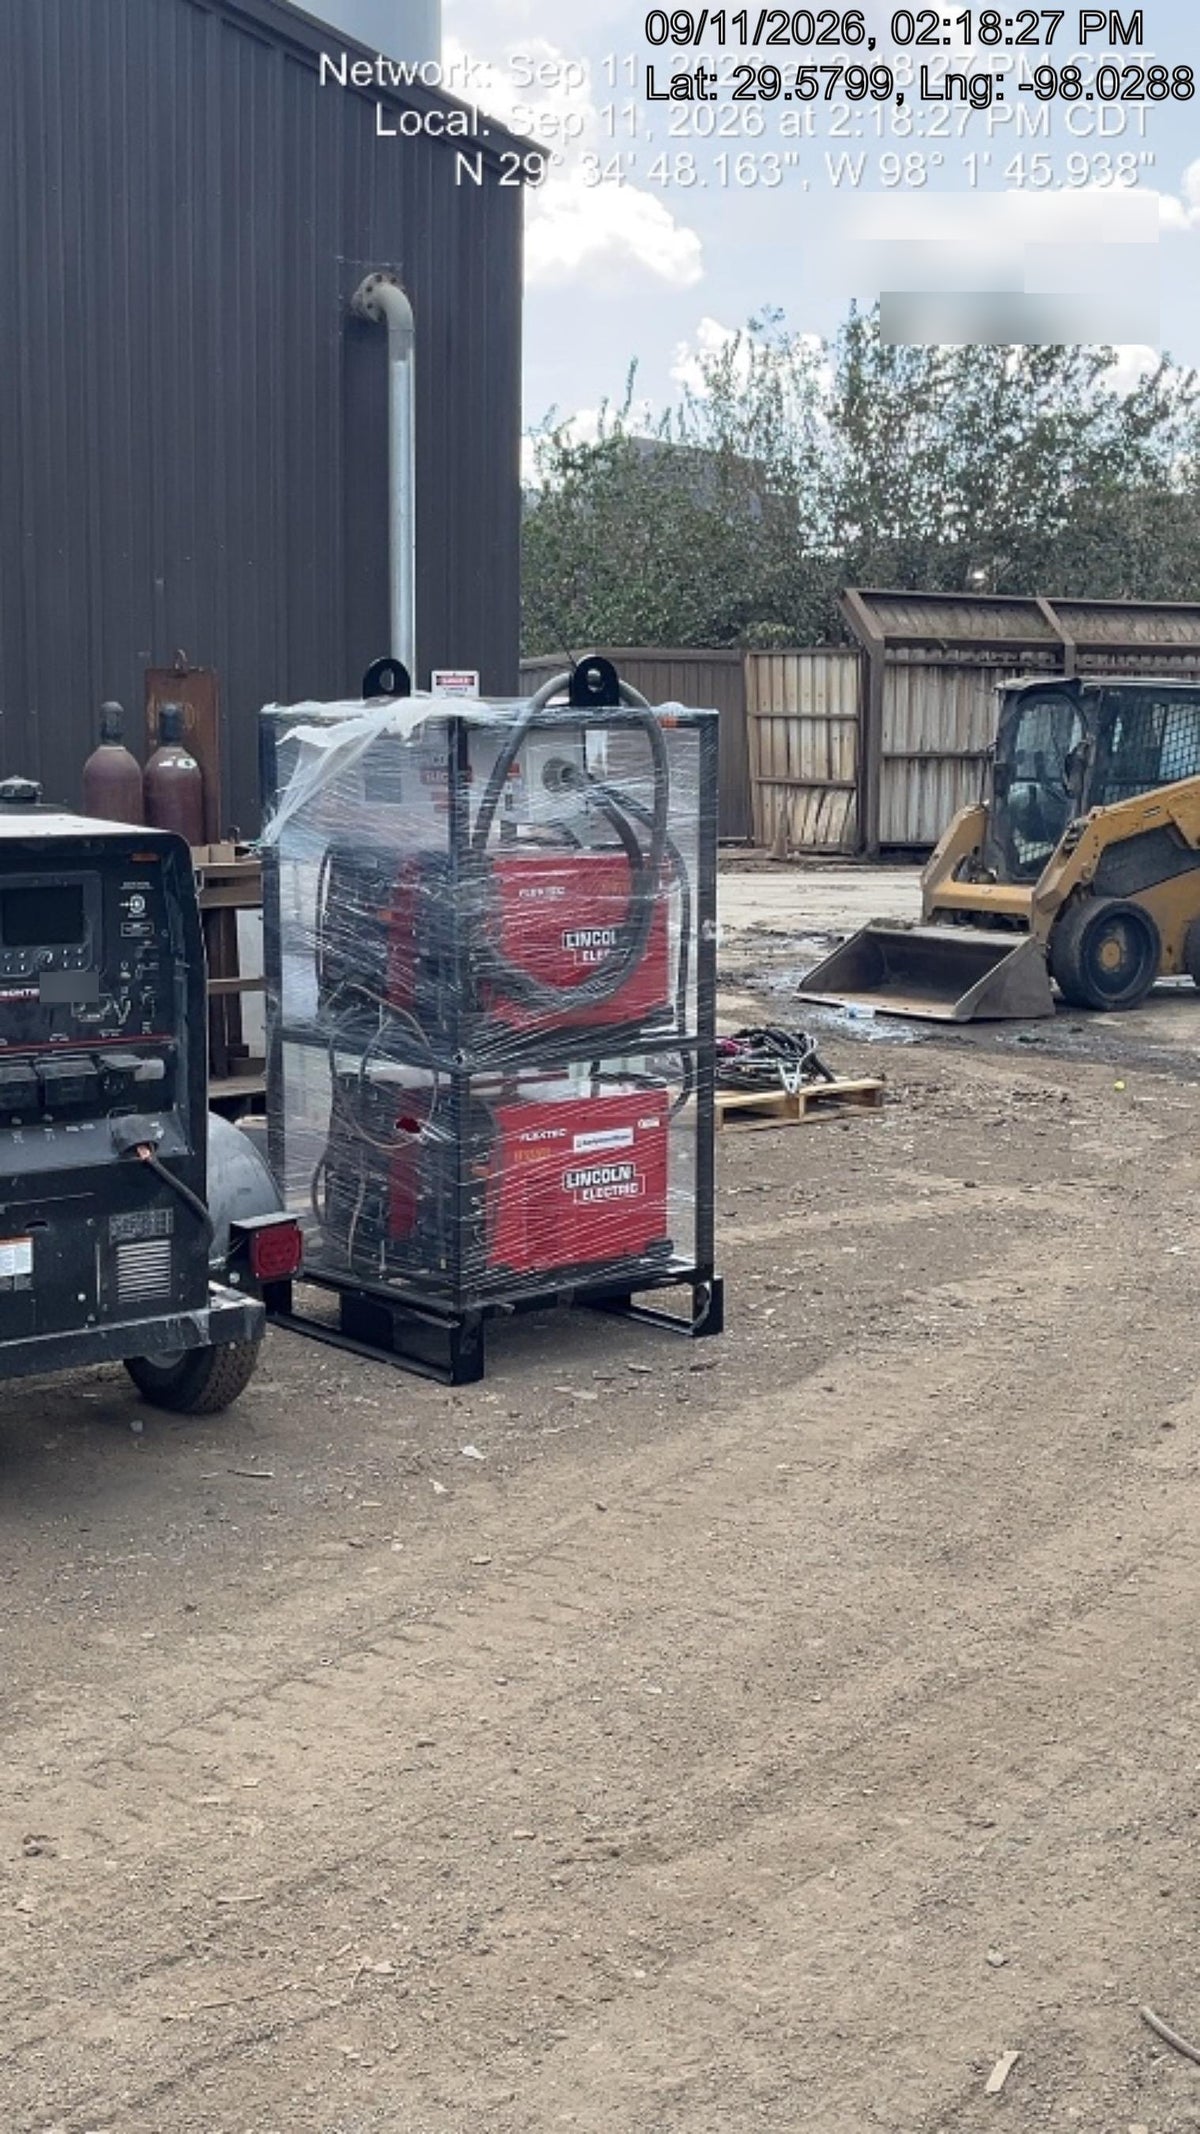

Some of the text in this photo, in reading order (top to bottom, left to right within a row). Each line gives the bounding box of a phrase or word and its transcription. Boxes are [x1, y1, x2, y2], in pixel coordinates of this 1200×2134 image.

[566, 930, 618, 949] LINCOL
[566, 1165, 632, 1188] LINCOLN
[582, 1182, 638, 1200] ELECTRIC
